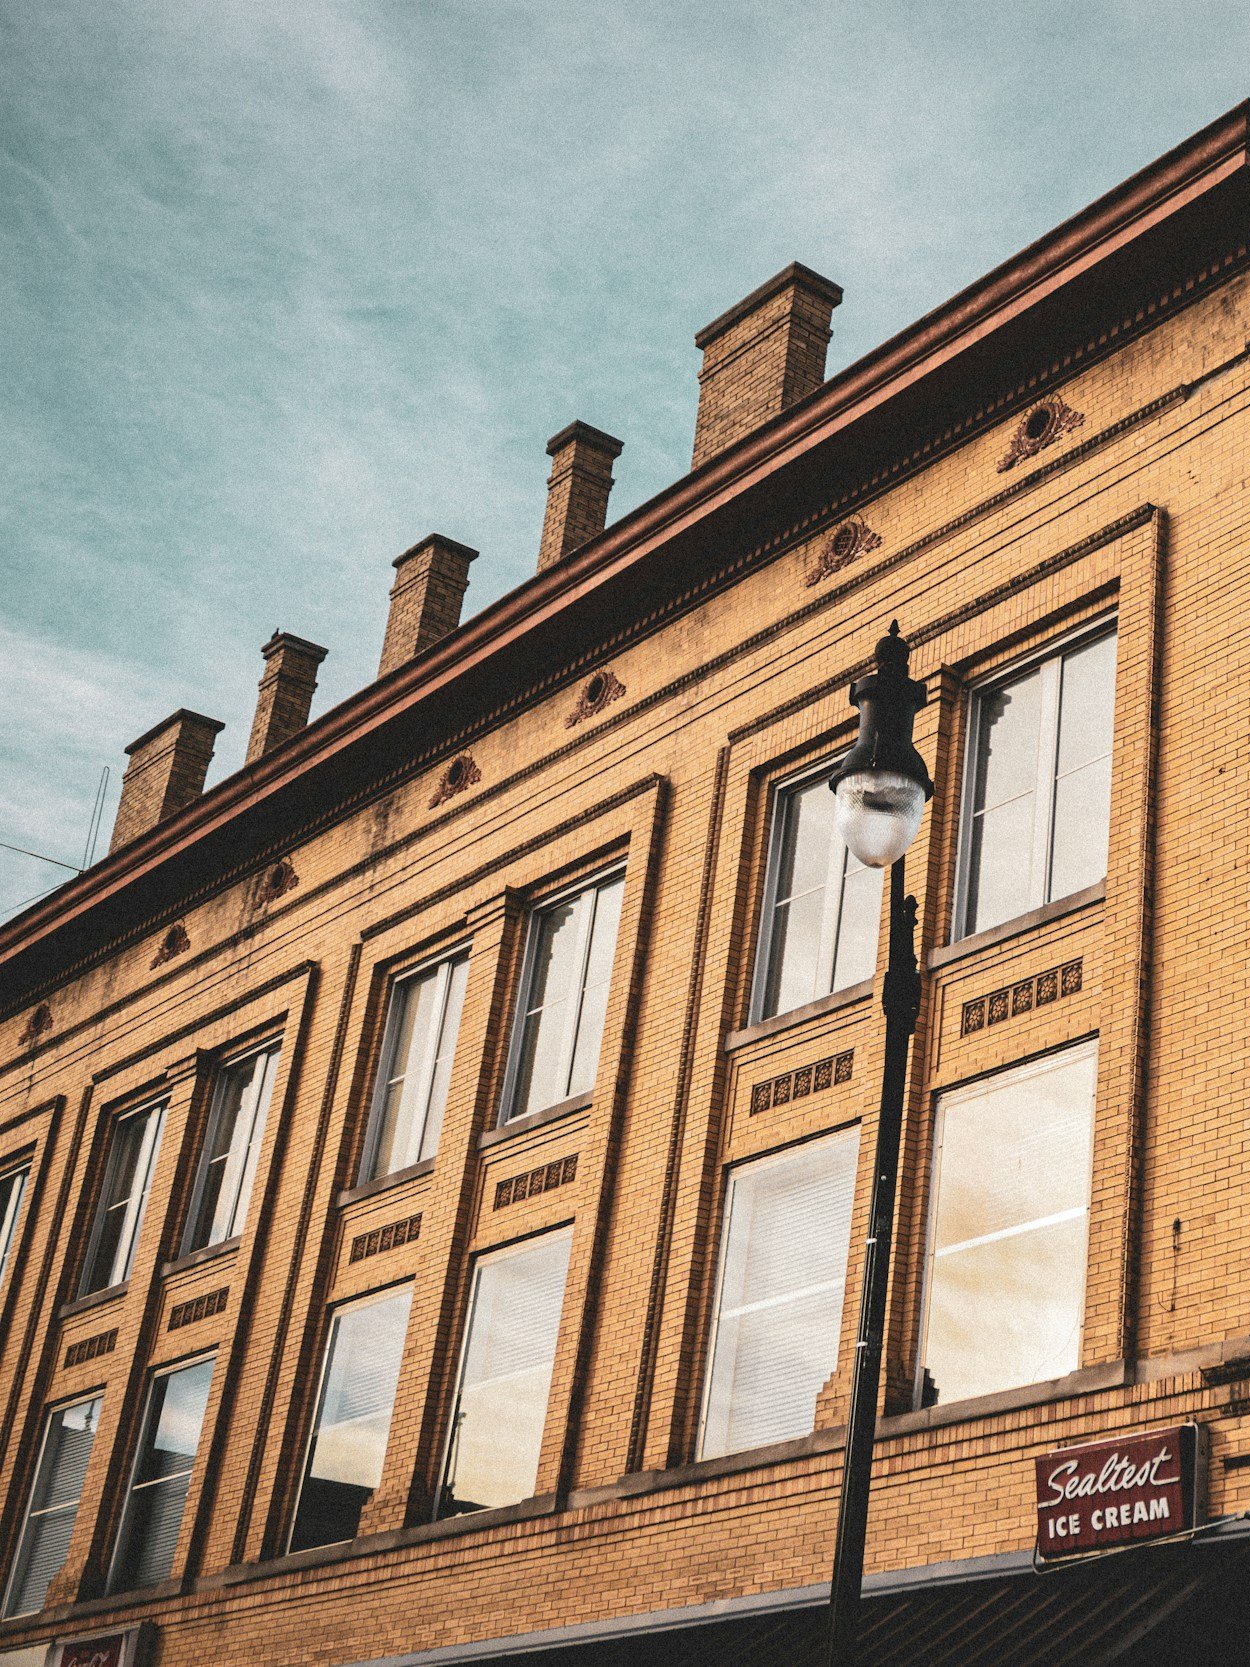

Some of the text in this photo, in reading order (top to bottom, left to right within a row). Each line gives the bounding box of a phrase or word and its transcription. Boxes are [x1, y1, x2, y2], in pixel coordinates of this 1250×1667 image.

[1037, 1446, 1180, 1509] Sealtest
[1048, 1497, 1170, 1539] ICE CREAM
